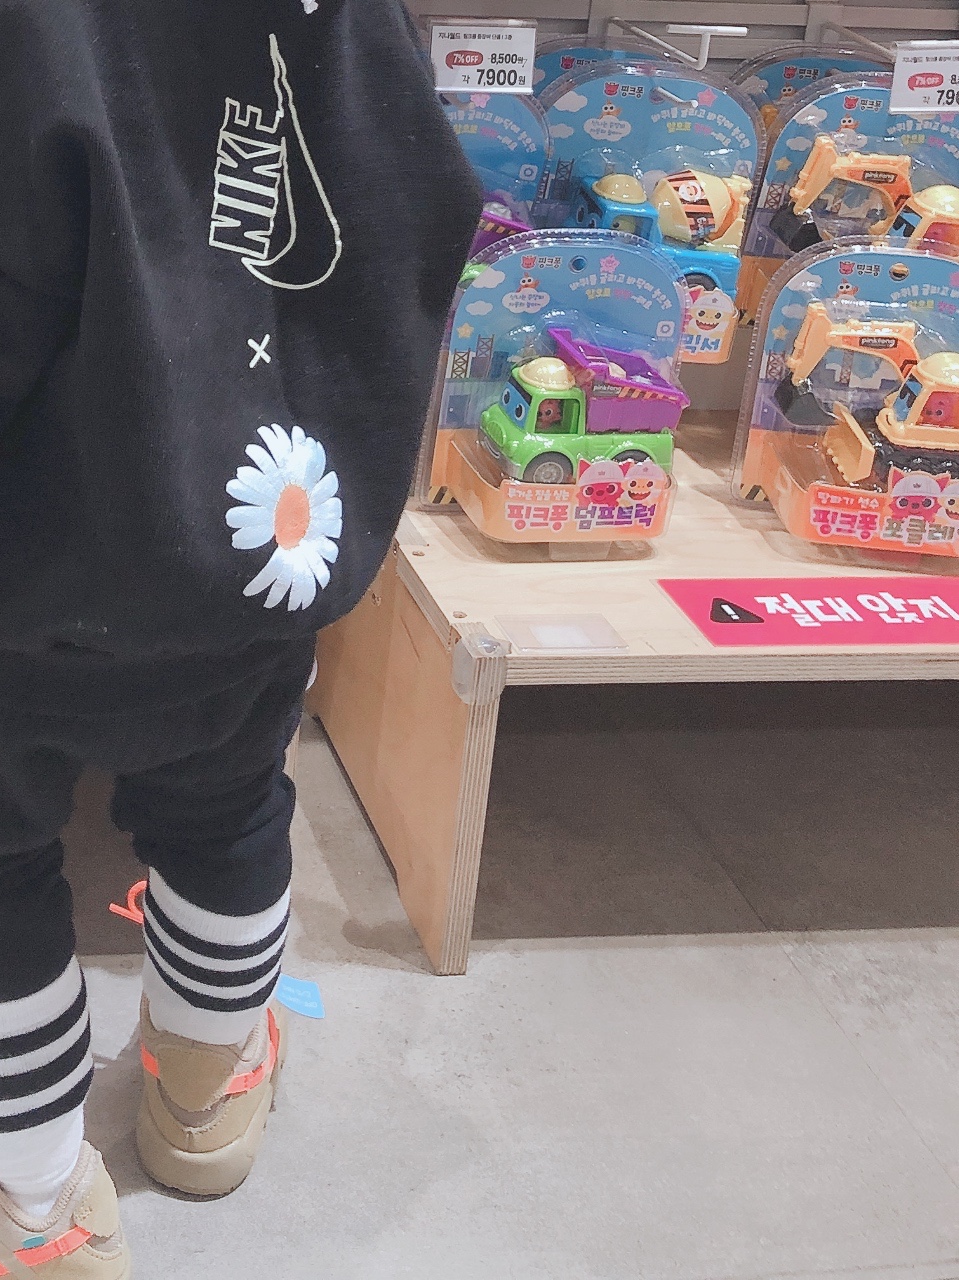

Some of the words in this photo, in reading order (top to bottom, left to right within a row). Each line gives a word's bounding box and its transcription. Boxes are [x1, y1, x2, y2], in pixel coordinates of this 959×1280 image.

[453, 53, 465, 64] 7%
[465, 55, 479, 64] OFF
[476, 68, 526, 86] 7,900원
[620, 85, 644, 99] 핑크퐁
[859, 98, 883, 112] 핑크퐁
[209, 97, 285, 260] NIKE
[538, 256, 562, 269] 핑크퐁
[856, 263, 882, 277] 핑크퐁
[861, 336, 896, 348] pinkfong
[593, 383, 622, 394] pinkfong
[507, 503, 569, 531] 핑크퐁
[574, 502, 657, 531] 덤프트럭
[812, 508, 879, 541] 핑크퐁
[882, 517, 959, 546] 포클레
[754, 592, 864, 628] 절대
[856, 591, 959, 624] 앉지
